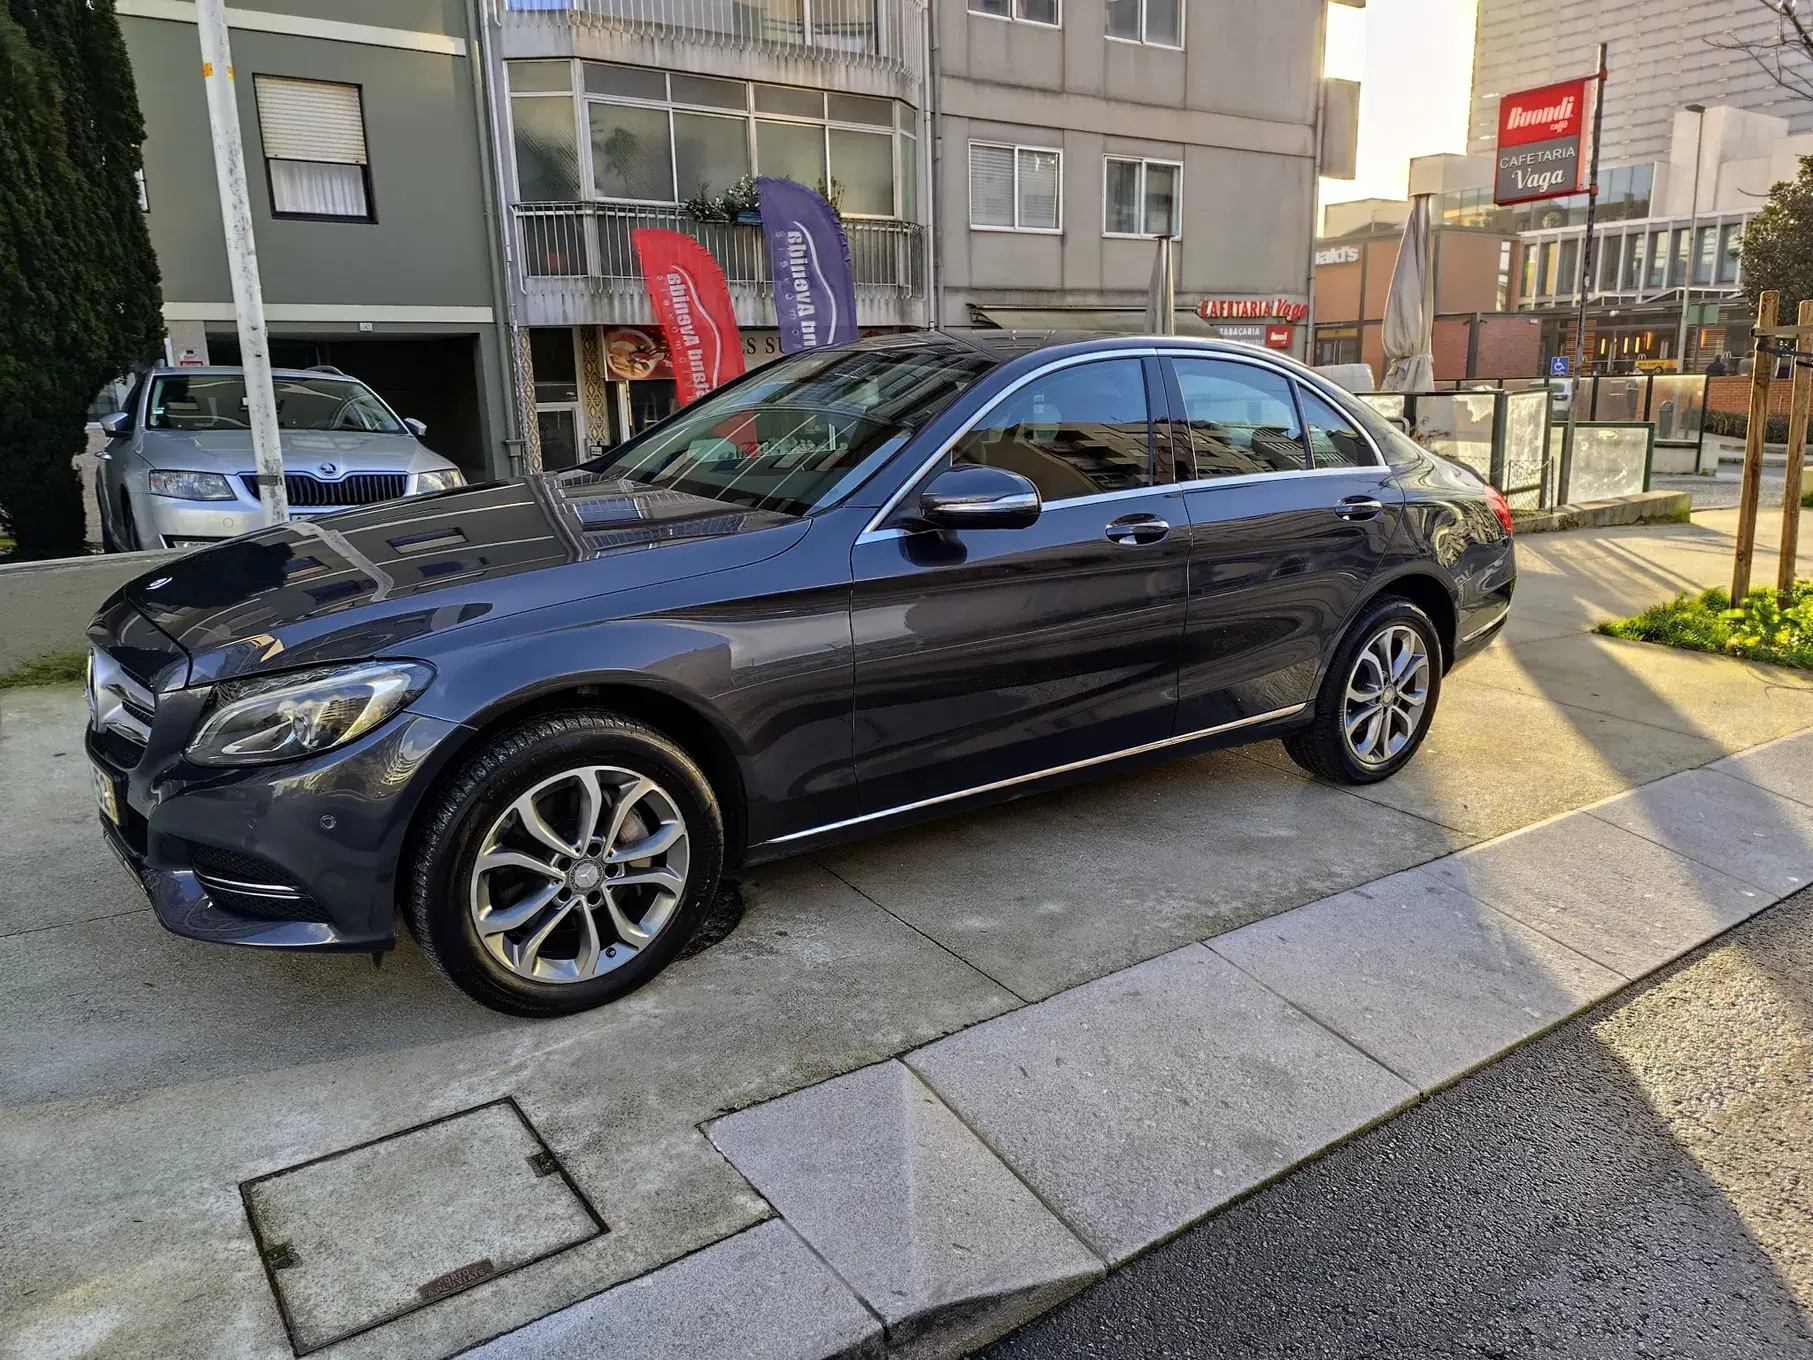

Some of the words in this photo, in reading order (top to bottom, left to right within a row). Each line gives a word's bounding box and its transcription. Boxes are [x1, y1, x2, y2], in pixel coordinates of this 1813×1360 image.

[1507, 96, 1575, 130] Buondi
[1500, 146, 1576, 169] CAFETARIA
[1512, 168, 1565, 193] Vaga
[1201, 300, 1271, 318] CAFETARIA
